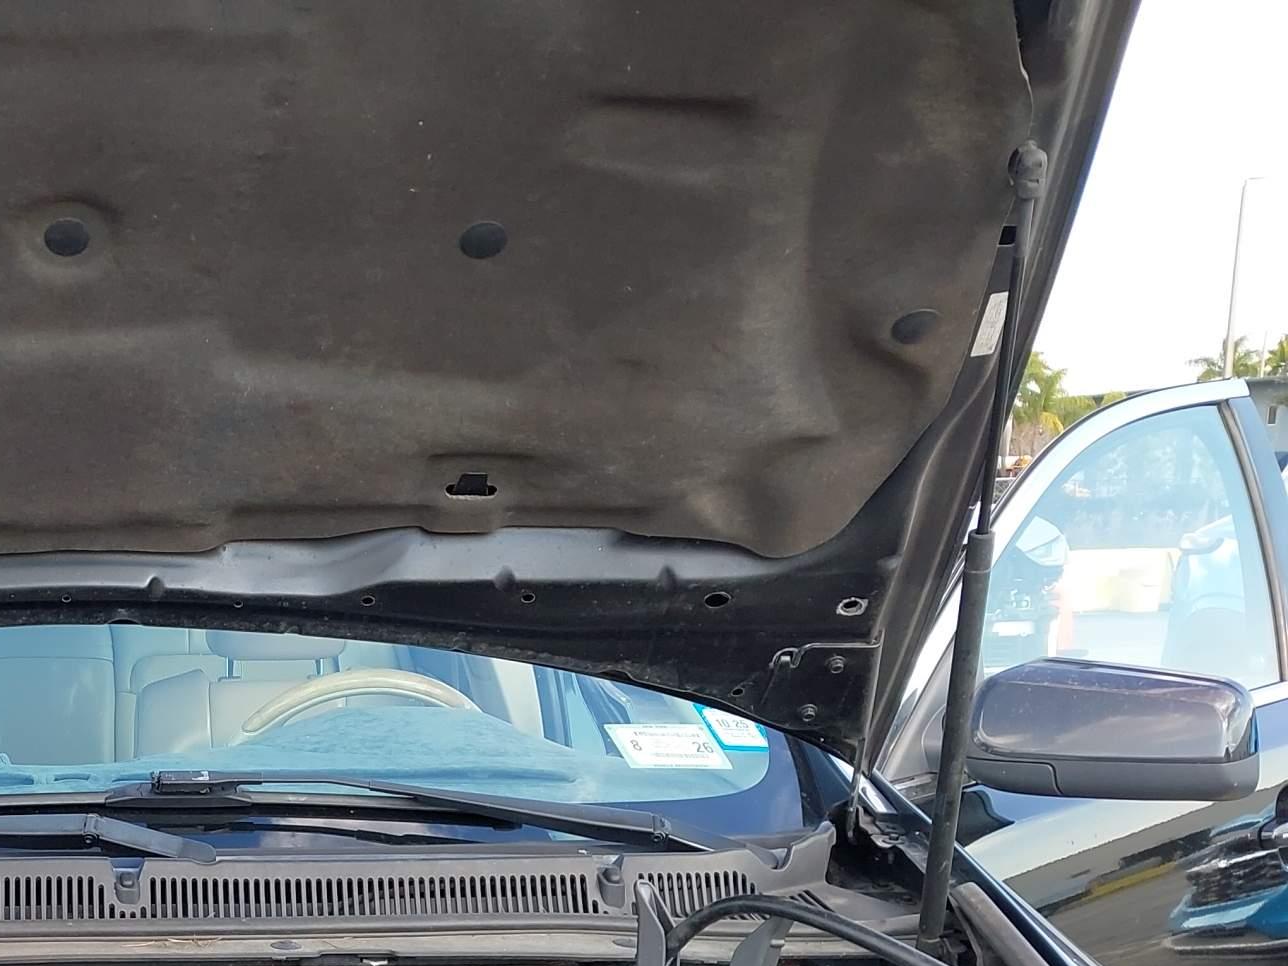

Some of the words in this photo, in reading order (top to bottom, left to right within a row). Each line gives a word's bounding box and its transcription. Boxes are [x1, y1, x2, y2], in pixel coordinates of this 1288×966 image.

[715, 719, 730, 728] 10
[732, 719, 749, 729] 25
[630, 739, 643, 752] 8
[692, 741, 714, 754] 26
